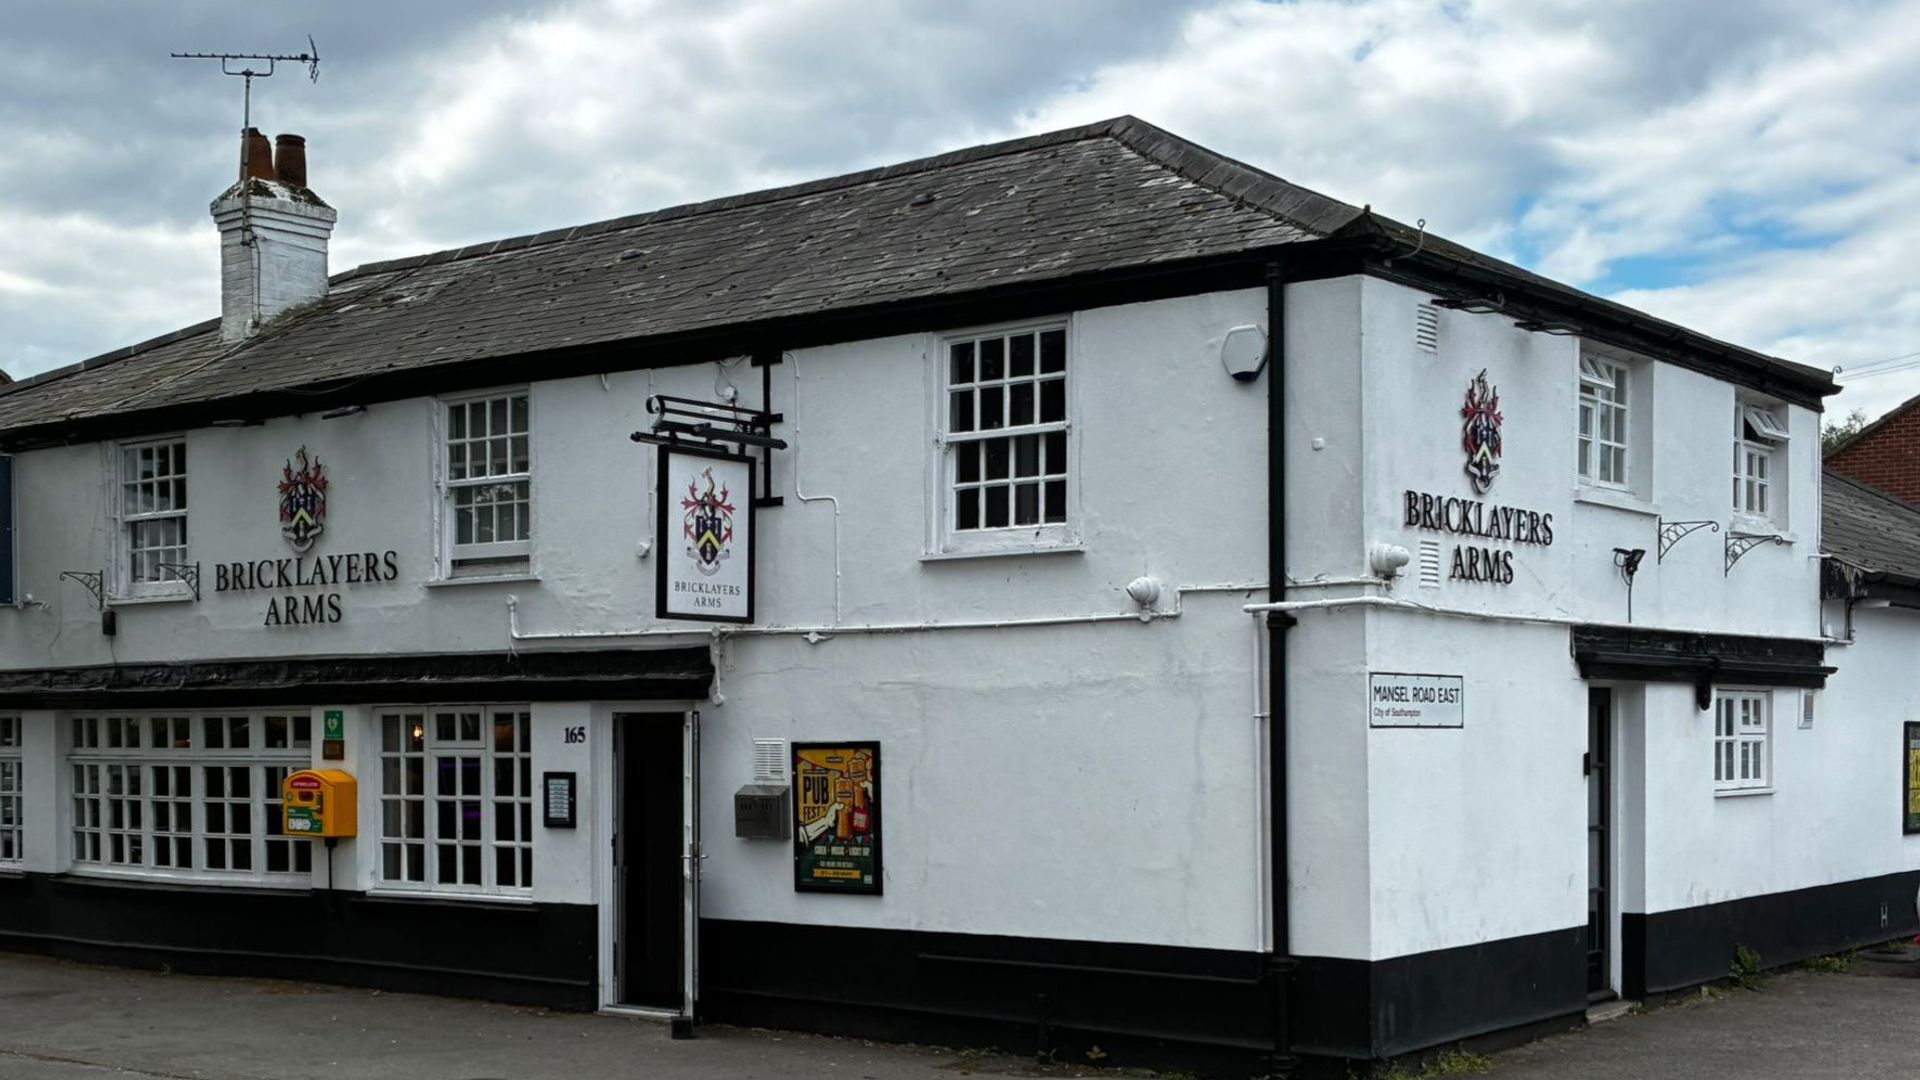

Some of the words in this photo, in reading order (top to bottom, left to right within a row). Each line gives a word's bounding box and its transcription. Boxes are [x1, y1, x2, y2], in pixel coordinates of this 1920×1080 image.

[1405, 489, 1553, 547] BRICKLAYERS
[215, 551, 398, 592] BRICKLAYERS
[1450, 545, 1513, 585] ARMS
[674, 581, 740, 596] BRICKLAYERS
[264, 593, 342, 626] ARMS
[693, 597, 722, 608] ARMS
[1374, 686, 1410, 702] MANSEL
[1412, 687, 1435, 703] ROAD
[1438, 688, 1460, 703] EAST
[1374, 707, 1384, 718] City
[1385, 707, 1391, 716] of
[1391, 707, 1421, 718] Southampton
[564, 726, 586, 744] 165
[803, 776, 829, 804] PUB
[803, 806, 820, 824] FEST
